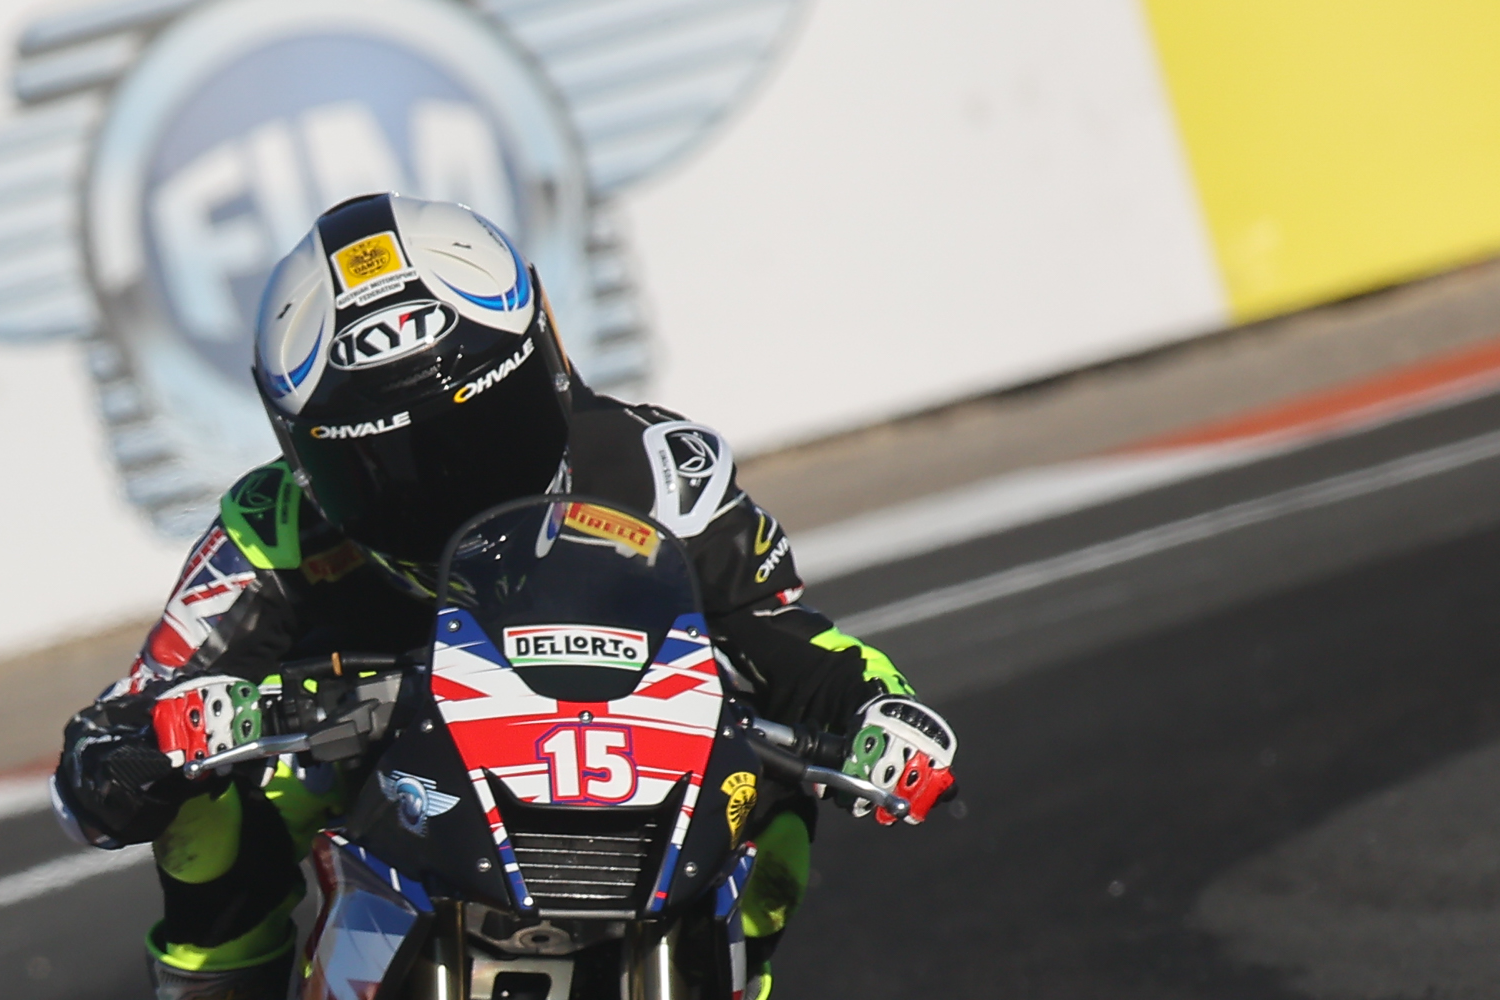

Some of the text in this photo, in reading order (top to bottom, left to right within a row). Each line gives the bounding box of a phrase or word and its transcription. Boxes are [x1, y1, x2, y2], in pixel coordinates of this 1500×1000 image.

[338, 271, 417, 304] AUSTRIAN MOTORSPORT
[359, 283, 401, 301] FEDERATION
[342, 302, 440, 367] KYT
[454, 337, 535, 404] OHVALE
[310, 410, 412, 440] OHVALE
[567, 502, 652, 547] PIRELLI
[515, 634, 638, 661] DELLORTO
[537, 725, 637, 802] 15
